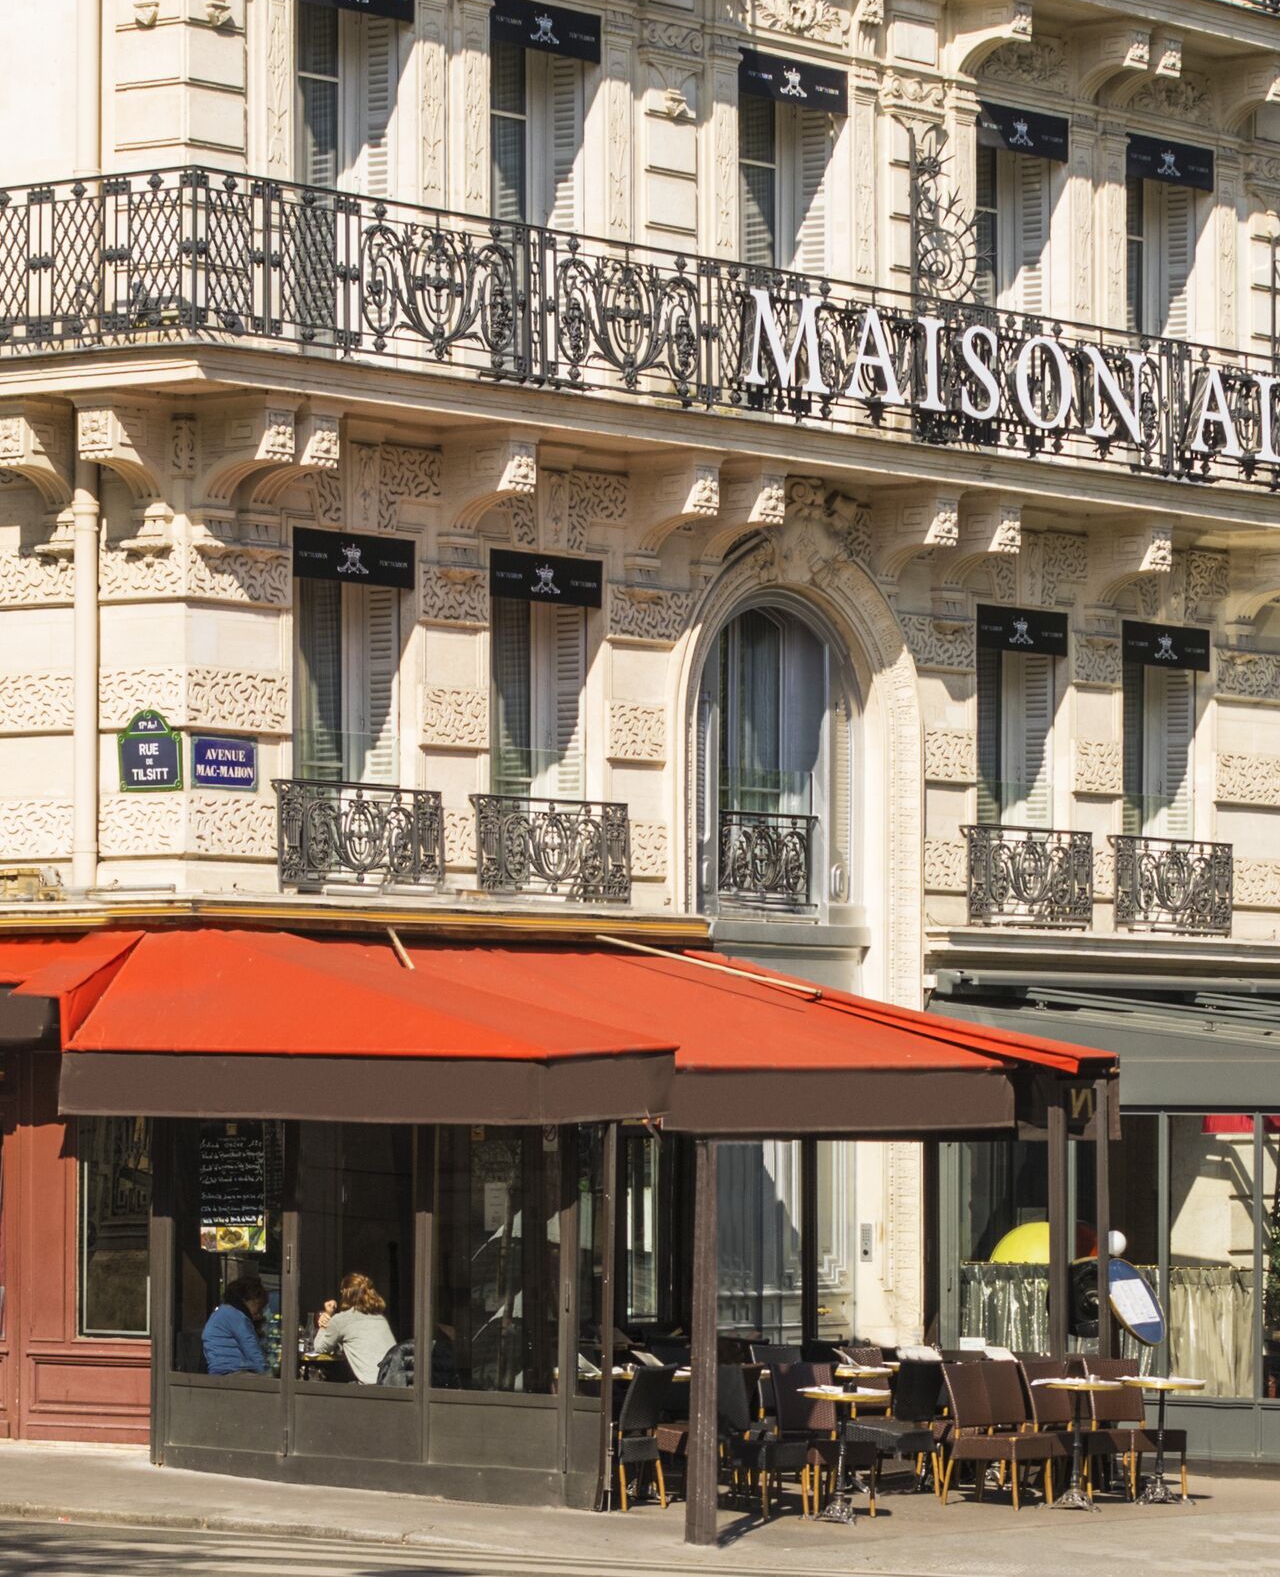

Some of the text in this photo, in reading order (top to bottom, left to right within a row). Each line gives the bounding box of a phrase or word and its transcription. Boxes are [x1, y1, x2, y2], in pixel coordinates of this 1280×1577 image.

[742, 288, 1151, 447] MAISON
[139, 743, 160, 756] RUE
[205, 748, 246, 762] AVENUE
[132, 767, 169, 782] TILSITT
[196, 764, 253, 779] MAC-MAHON
